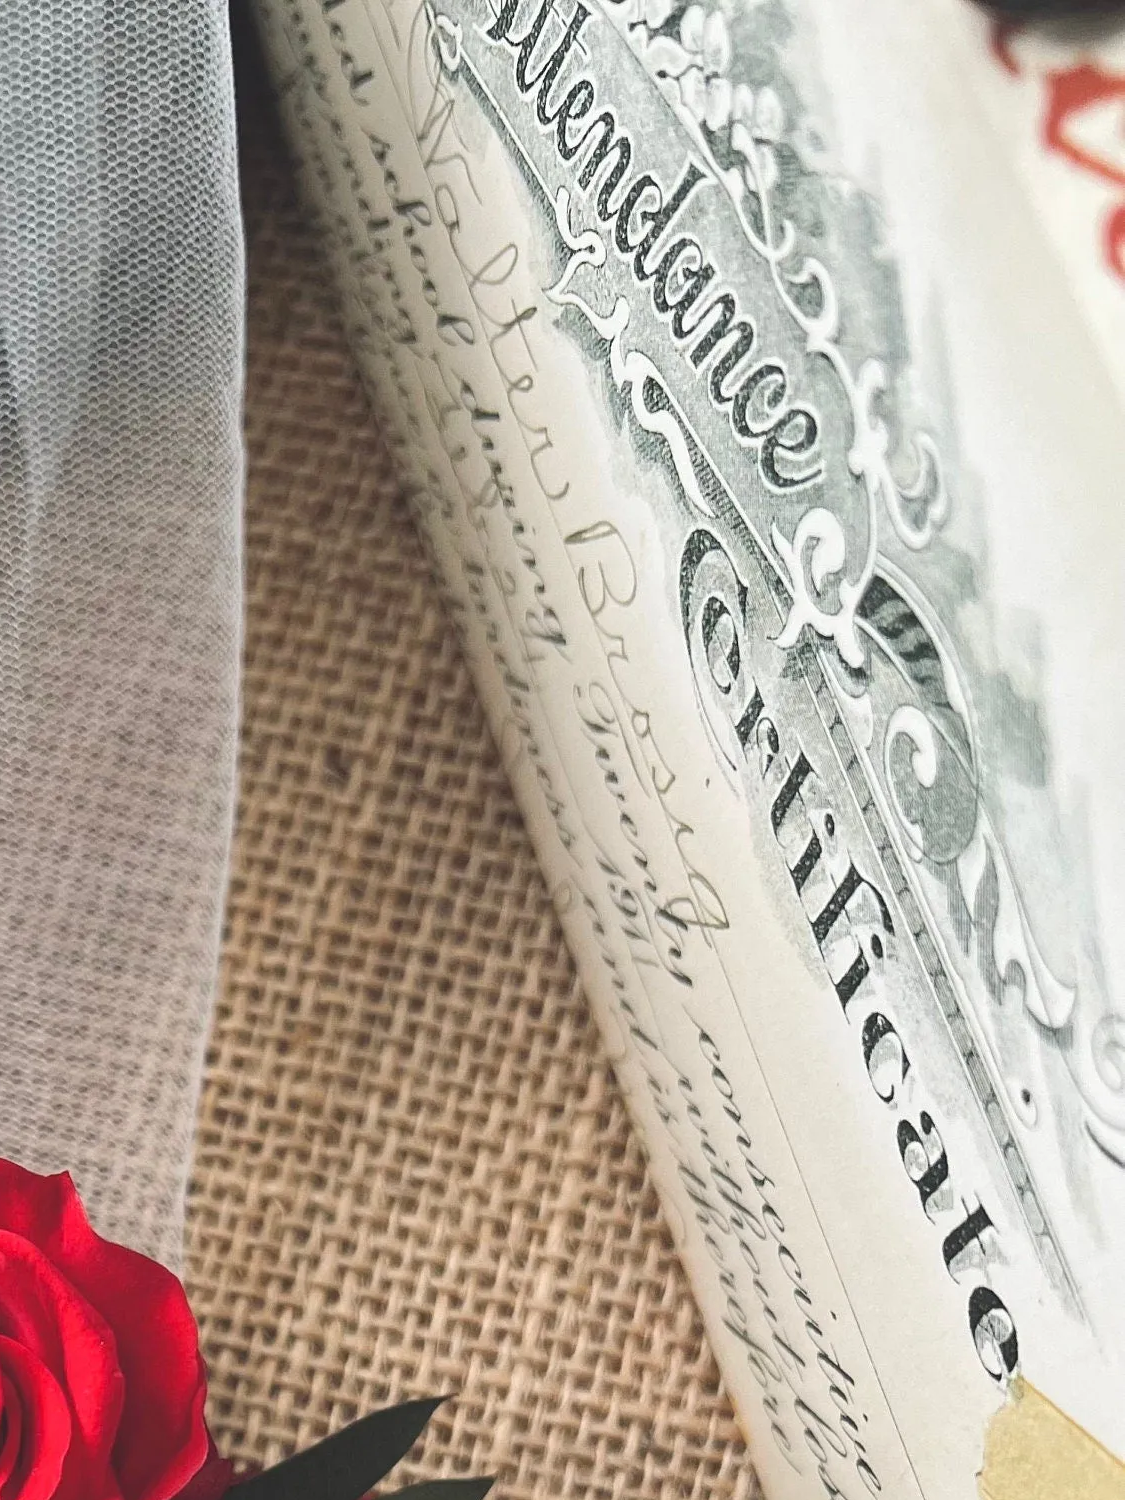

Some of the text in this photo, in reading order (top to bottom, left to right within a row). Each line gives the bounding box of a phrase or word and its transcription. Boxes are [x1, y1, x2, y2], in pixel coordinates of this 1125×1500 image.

[361, 126, 474, 345] school
[452, 370, 573, 662] during
[573, 683, 693, 987] Twenty
[572, 882, 659, 1052] and
[643, 1063, 680, 1142] is
[673, 1148, 801, 1475] therefore
[668, 1062, 806, 1382] without
[679, 529, 1019, 1386] Certificate
